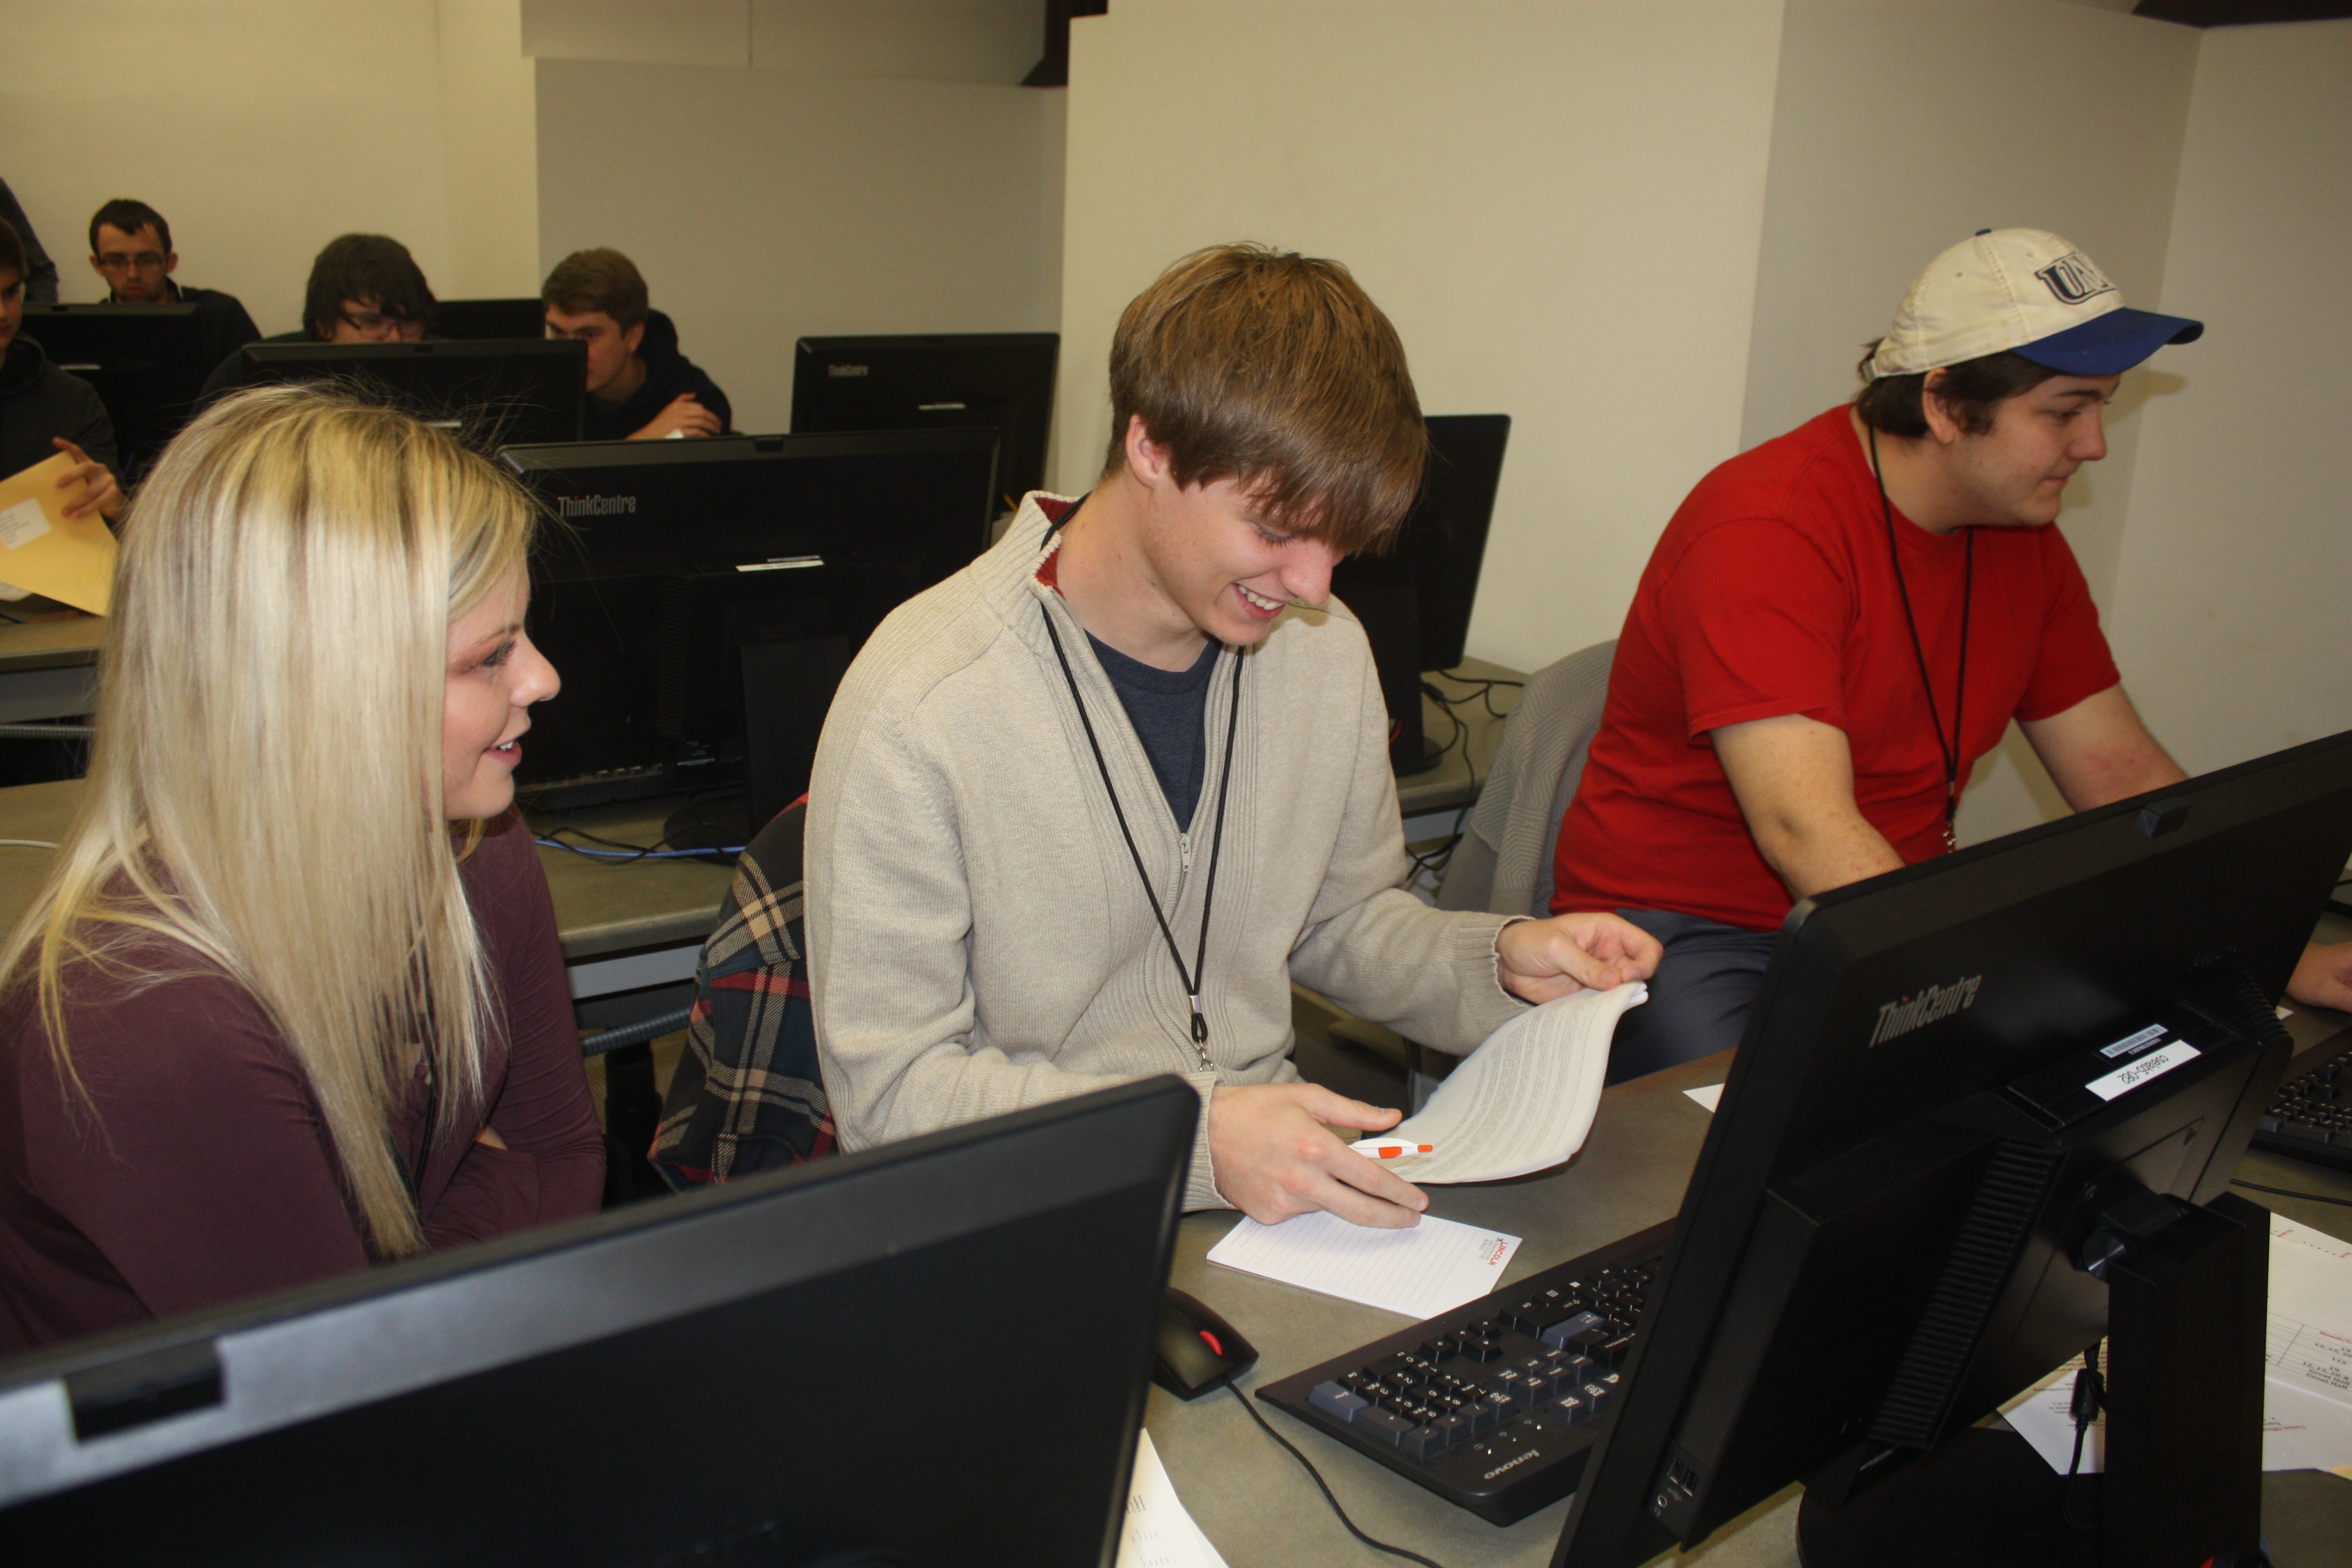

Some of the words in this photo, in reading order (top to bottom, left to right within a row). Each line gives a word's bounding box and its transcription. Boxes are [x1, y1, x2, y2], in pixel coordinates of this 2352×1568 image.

[558, 494, 636, 516] ThinkCentre
[1869, 974, 1982, 1048] ThinkCentre
[2116, 1055, 2169, 1084] cselab5-082
[1488, 1242, 1509, 1266] LINCOLN
[1484, 1449, 1540, 1480] lenovo
